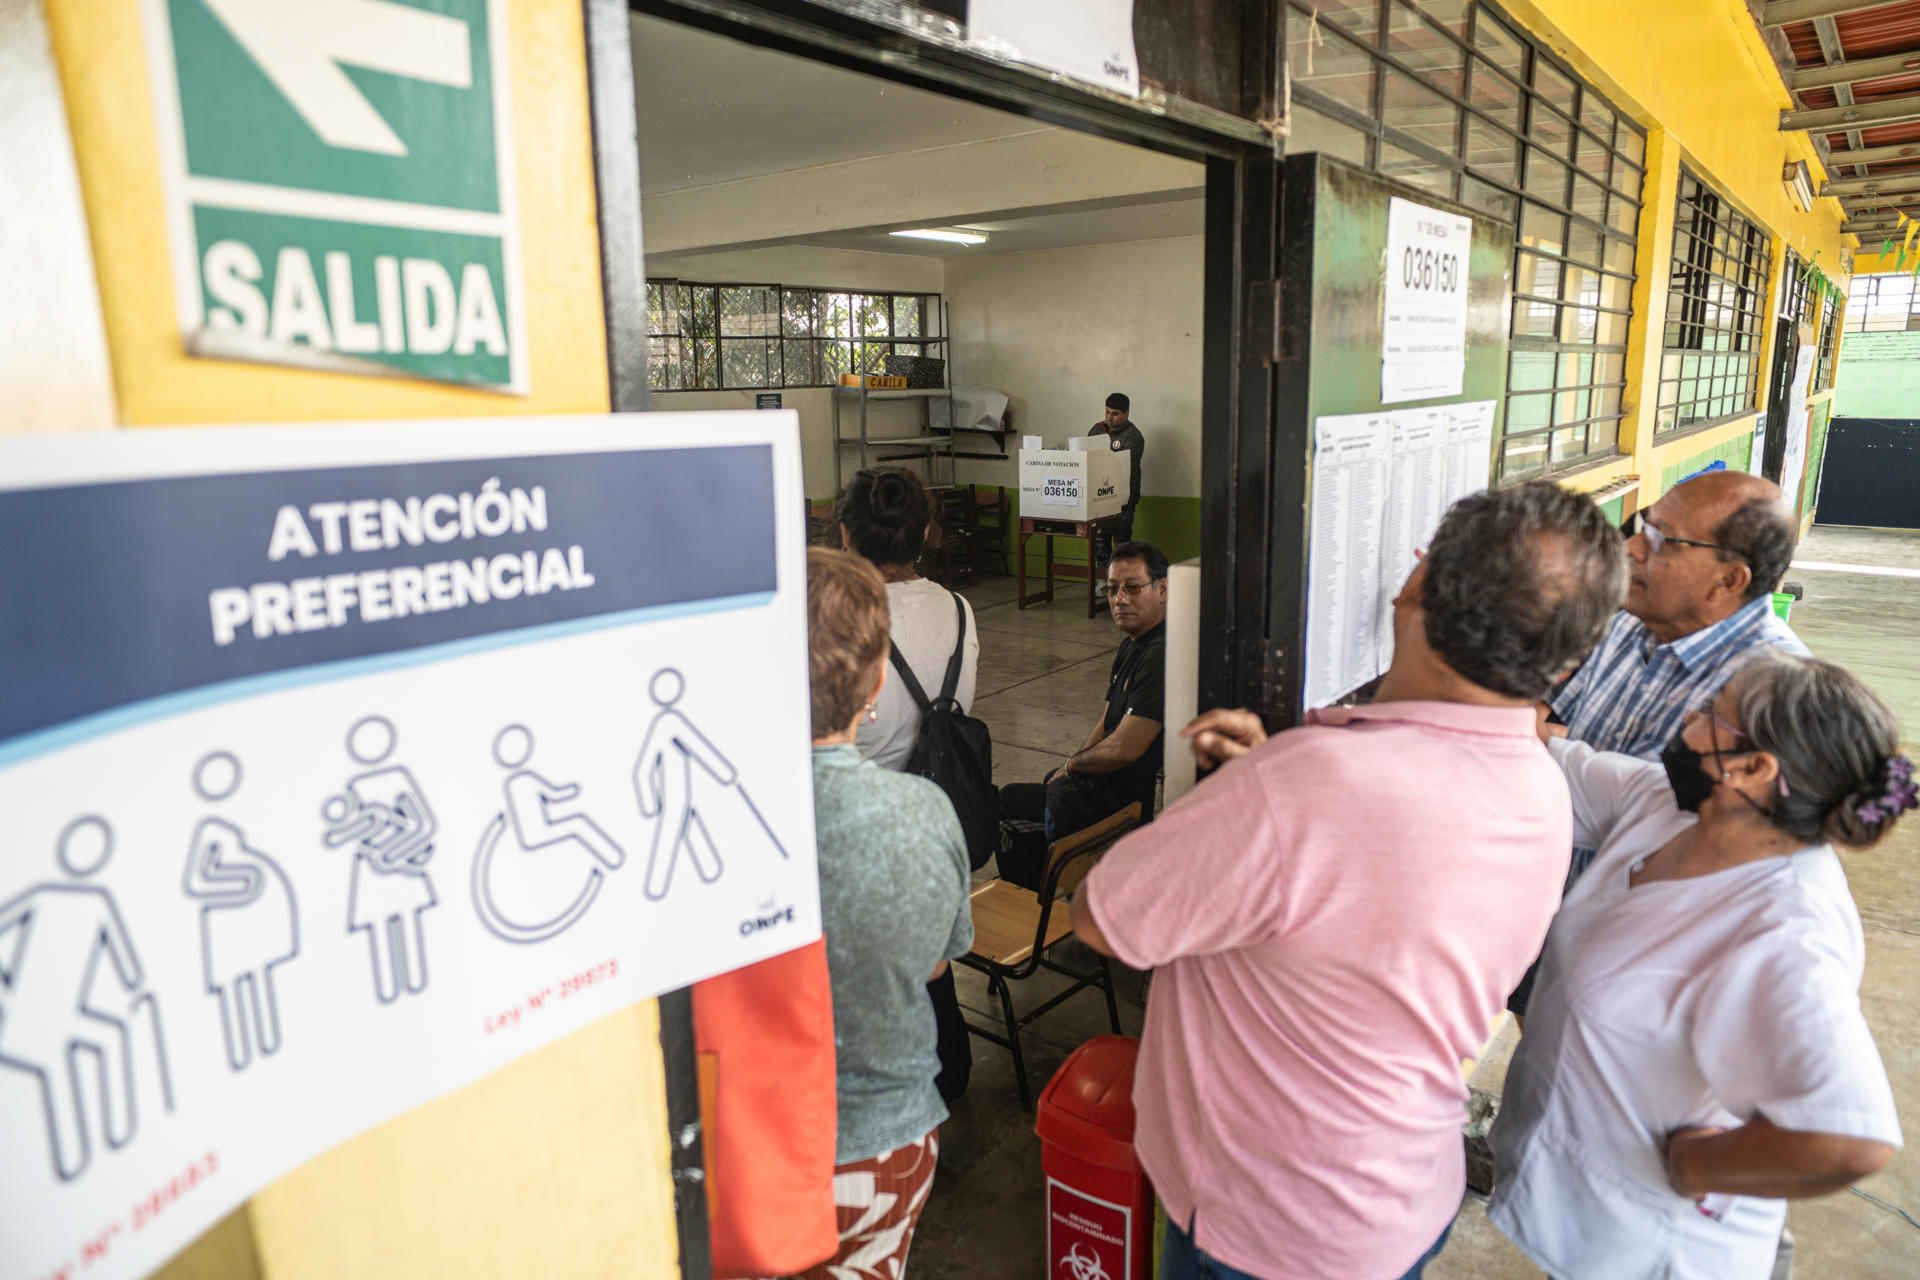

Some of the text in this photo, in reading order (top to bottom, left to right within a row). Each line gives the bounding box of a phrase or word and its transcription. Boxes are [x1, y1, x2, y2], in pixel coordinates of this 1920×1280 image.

[1103, 60, 1130, 81] ONPE
[1403, 246, 1458, 293] 036150
[203, 239, 510, 356] SALIDA
[1044, 486, 1078, 497] 036150
[1097, 485, 1114, 497] ONPE
[267, 476, 548, 562] ATENCIÓN
[209, 545, 596, 646] PREFERENCIAL
[738, 904, 795, 937] ONPE
[484, 1004, 521, 1036] Ley
[1069, 1212, 1103, 1232] RESIDUO
